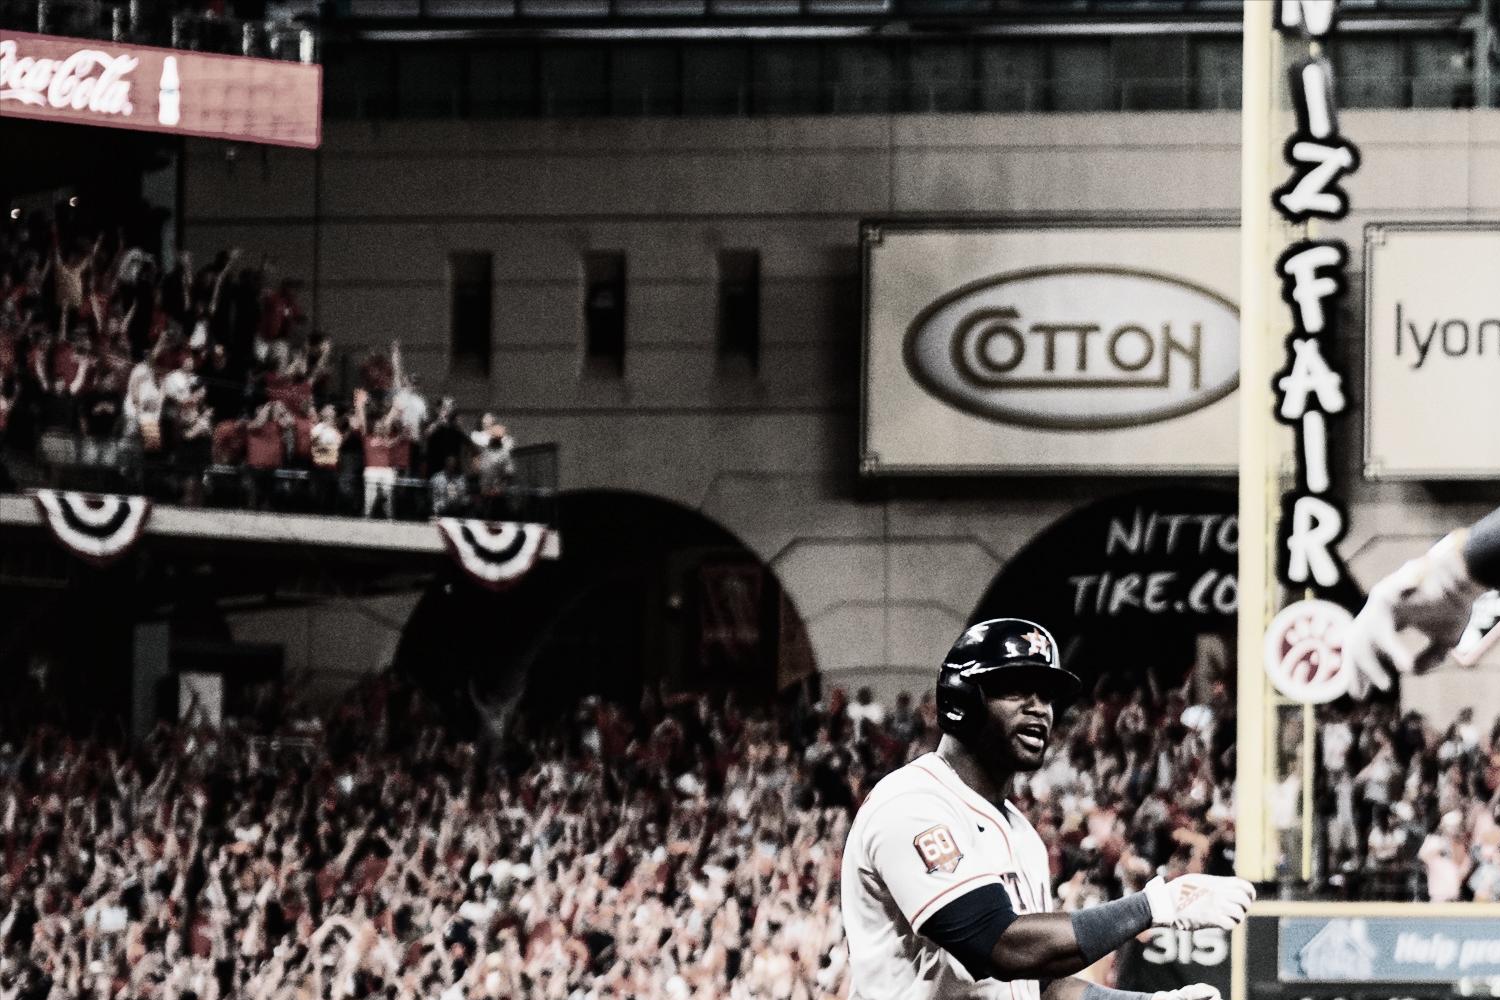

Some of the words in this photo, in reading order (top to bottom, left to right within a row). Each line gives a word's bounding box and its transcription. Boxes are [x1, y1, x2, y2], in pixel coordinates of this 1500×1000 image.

[0, 39, 139, 116] oca-Cola
[950, 305, 1202, 391] COTTON
[1278, 245, 1345, 588] FAIR
[1067, 569, 1239, 616] TIRE.CO
[919, 826, 952, 861] 60
[1143, 926, 1228, 966] 315
